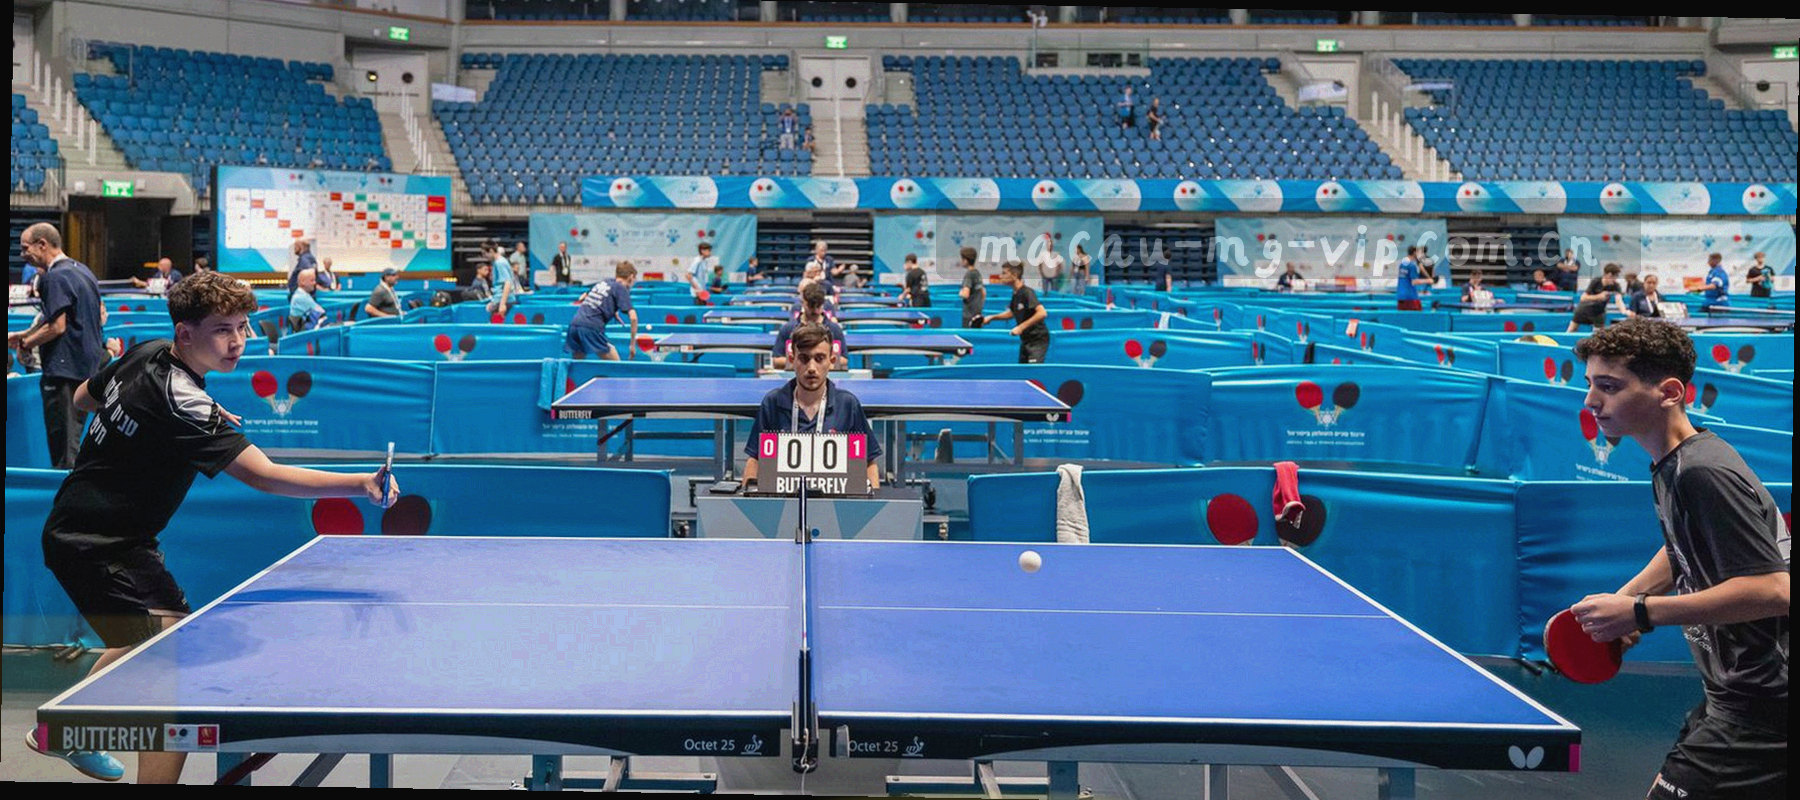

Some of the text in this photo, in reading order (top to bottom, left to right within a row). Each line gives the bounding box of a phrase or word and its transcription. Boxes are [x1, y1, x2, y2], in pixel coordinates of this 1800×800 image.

[558, 410, 593, 419] BUTTERFLY
[763, 438, 861, 470] 0 0 0 1
[62, 726, 157, 751] BUTTERFLY
[684, 738, 718, 751] Octet
[721, 739, 736, 751] 25
[848, 740, 880, 752] Octet
[884, 741, 899, 752] 25
